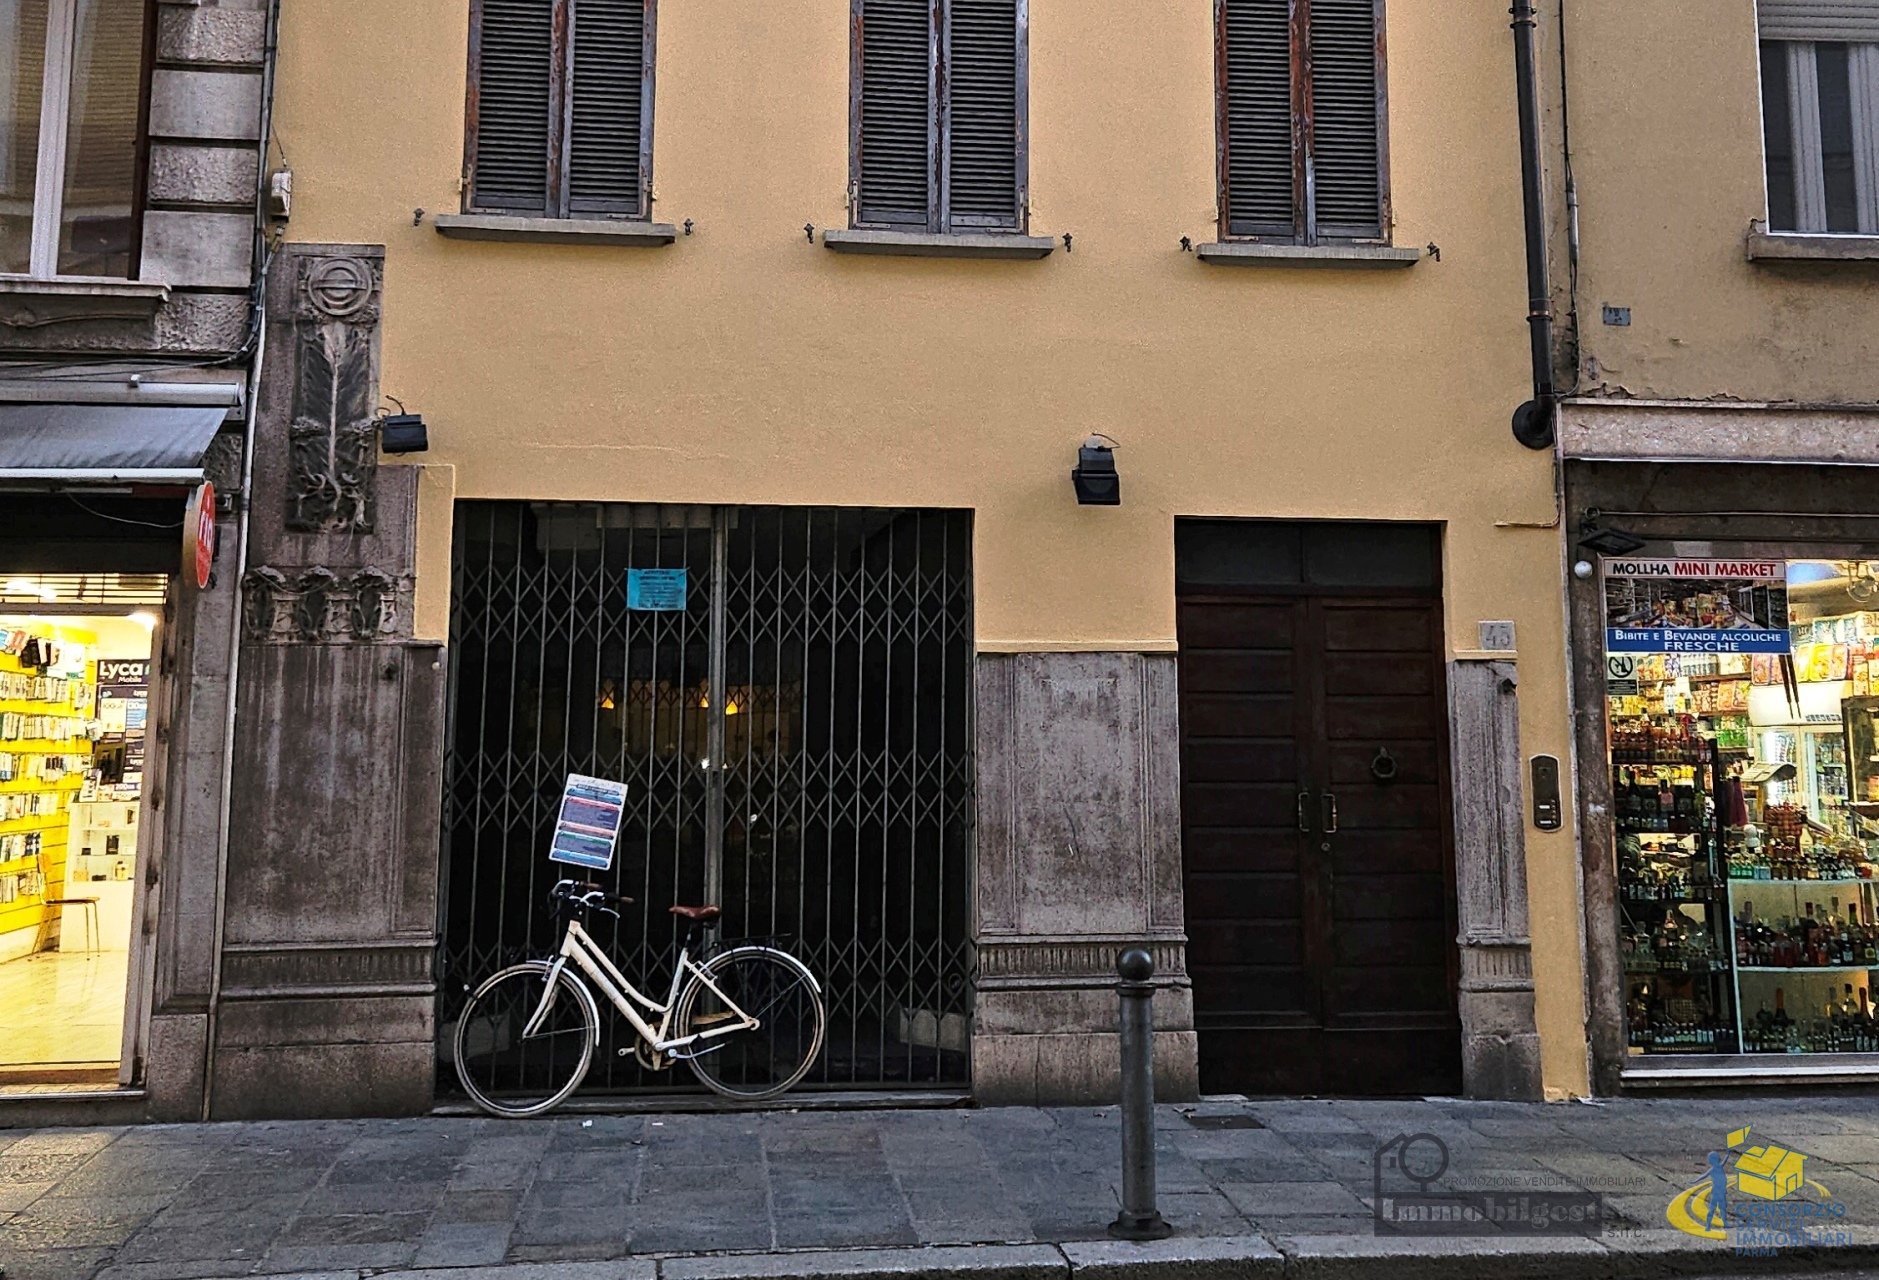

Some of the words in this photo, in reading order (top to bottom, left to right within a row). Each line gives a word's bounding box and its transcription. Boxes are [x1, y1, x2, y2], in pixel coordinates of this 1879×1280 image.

[1613, 563, 1670, 575] MOLLHA
[1674, 562, 1710, 576] MINI
[1715, 563, 1776, 576] MARKET
[1721, 632, 1782, 642] ALCOLICHE
[1664, 641, 1740, 652] FRESCHE
[99, 661, 144, 679] Lyca
